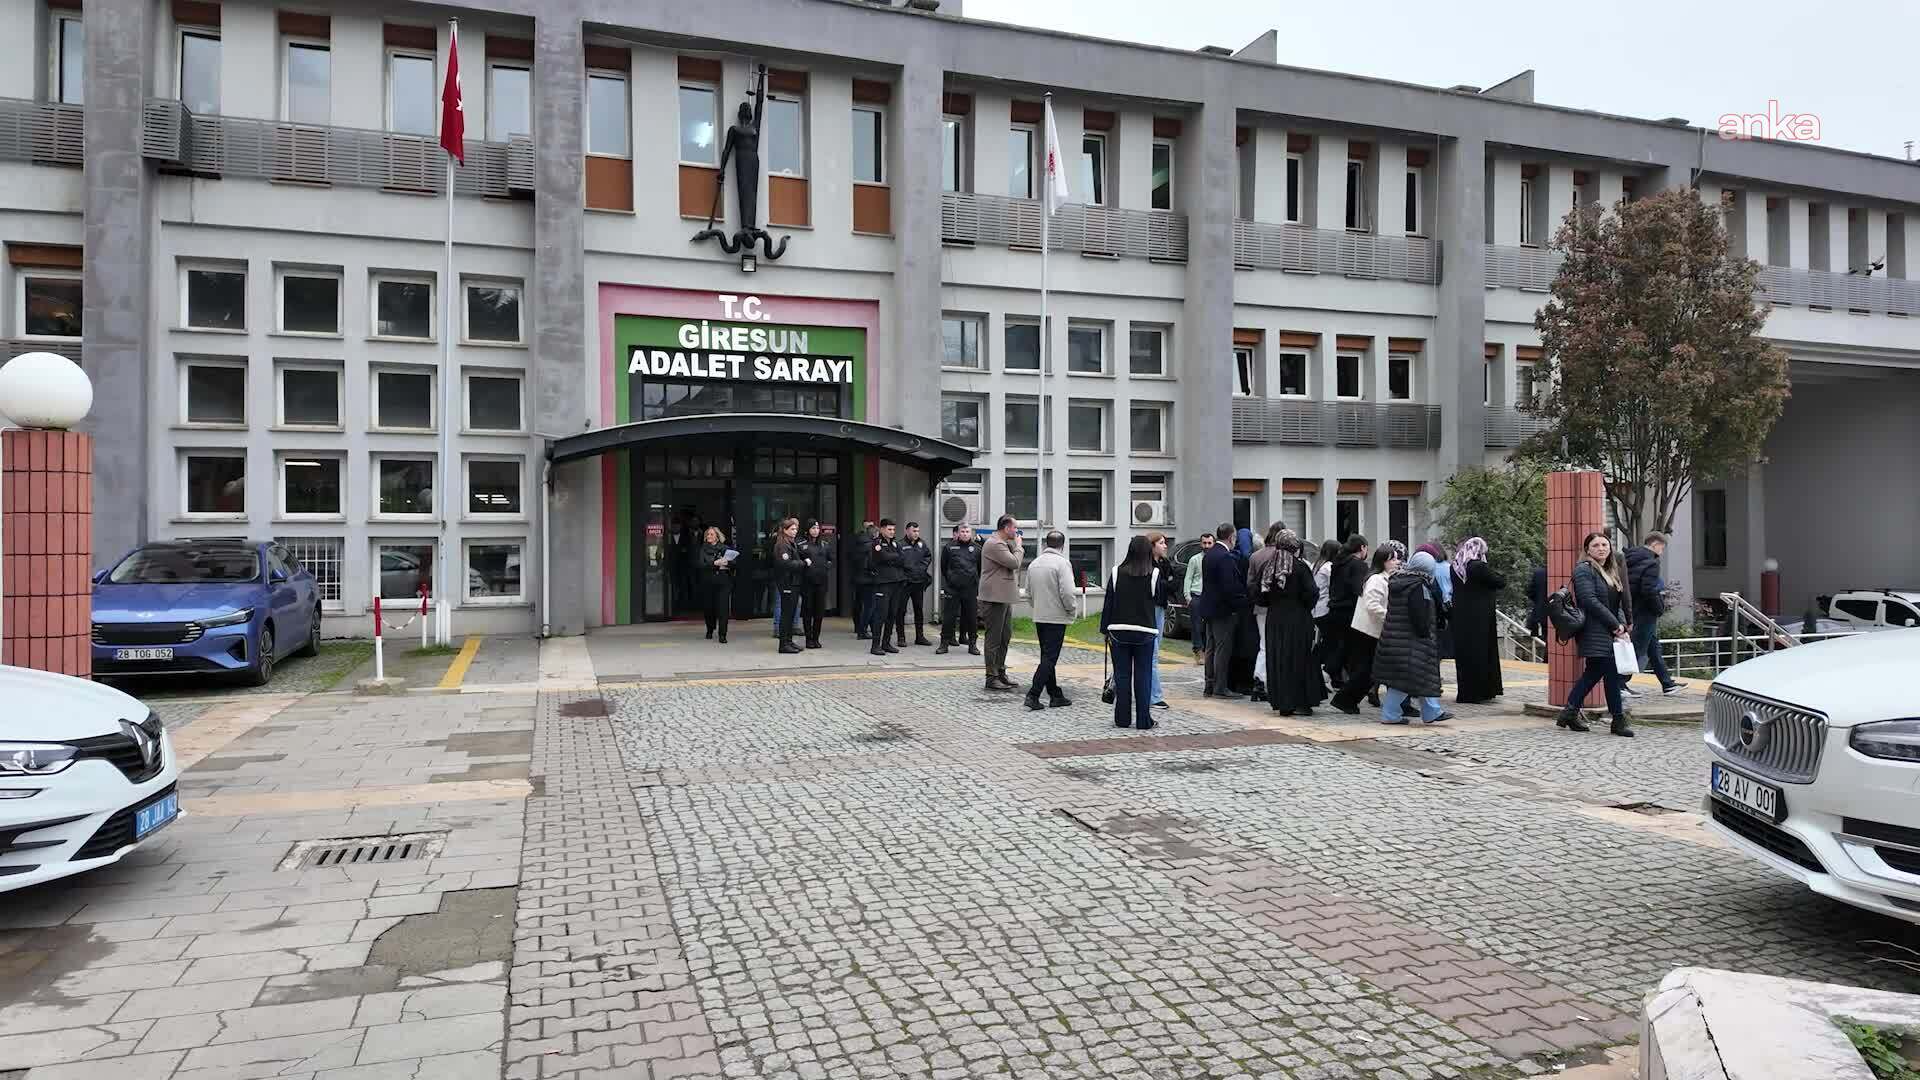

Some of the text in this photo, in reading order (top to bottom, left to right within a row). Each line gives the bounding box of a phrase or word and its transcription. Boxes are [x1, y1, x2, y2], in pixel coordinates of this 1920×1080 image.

[719, 294, 771, 321] T.C.
[678, 320, 809, 354] GİRESUN
[628, 349, 853, 384] ADALET SARAYI
[118, 648, 172, 659] 28 TOG 052
[1718, 770, 1730, 793] 28
[1734, 776, 1750, 801] AV
[1755, 786, 1775, 815] 001
[140, 810, 150, 832] 28
